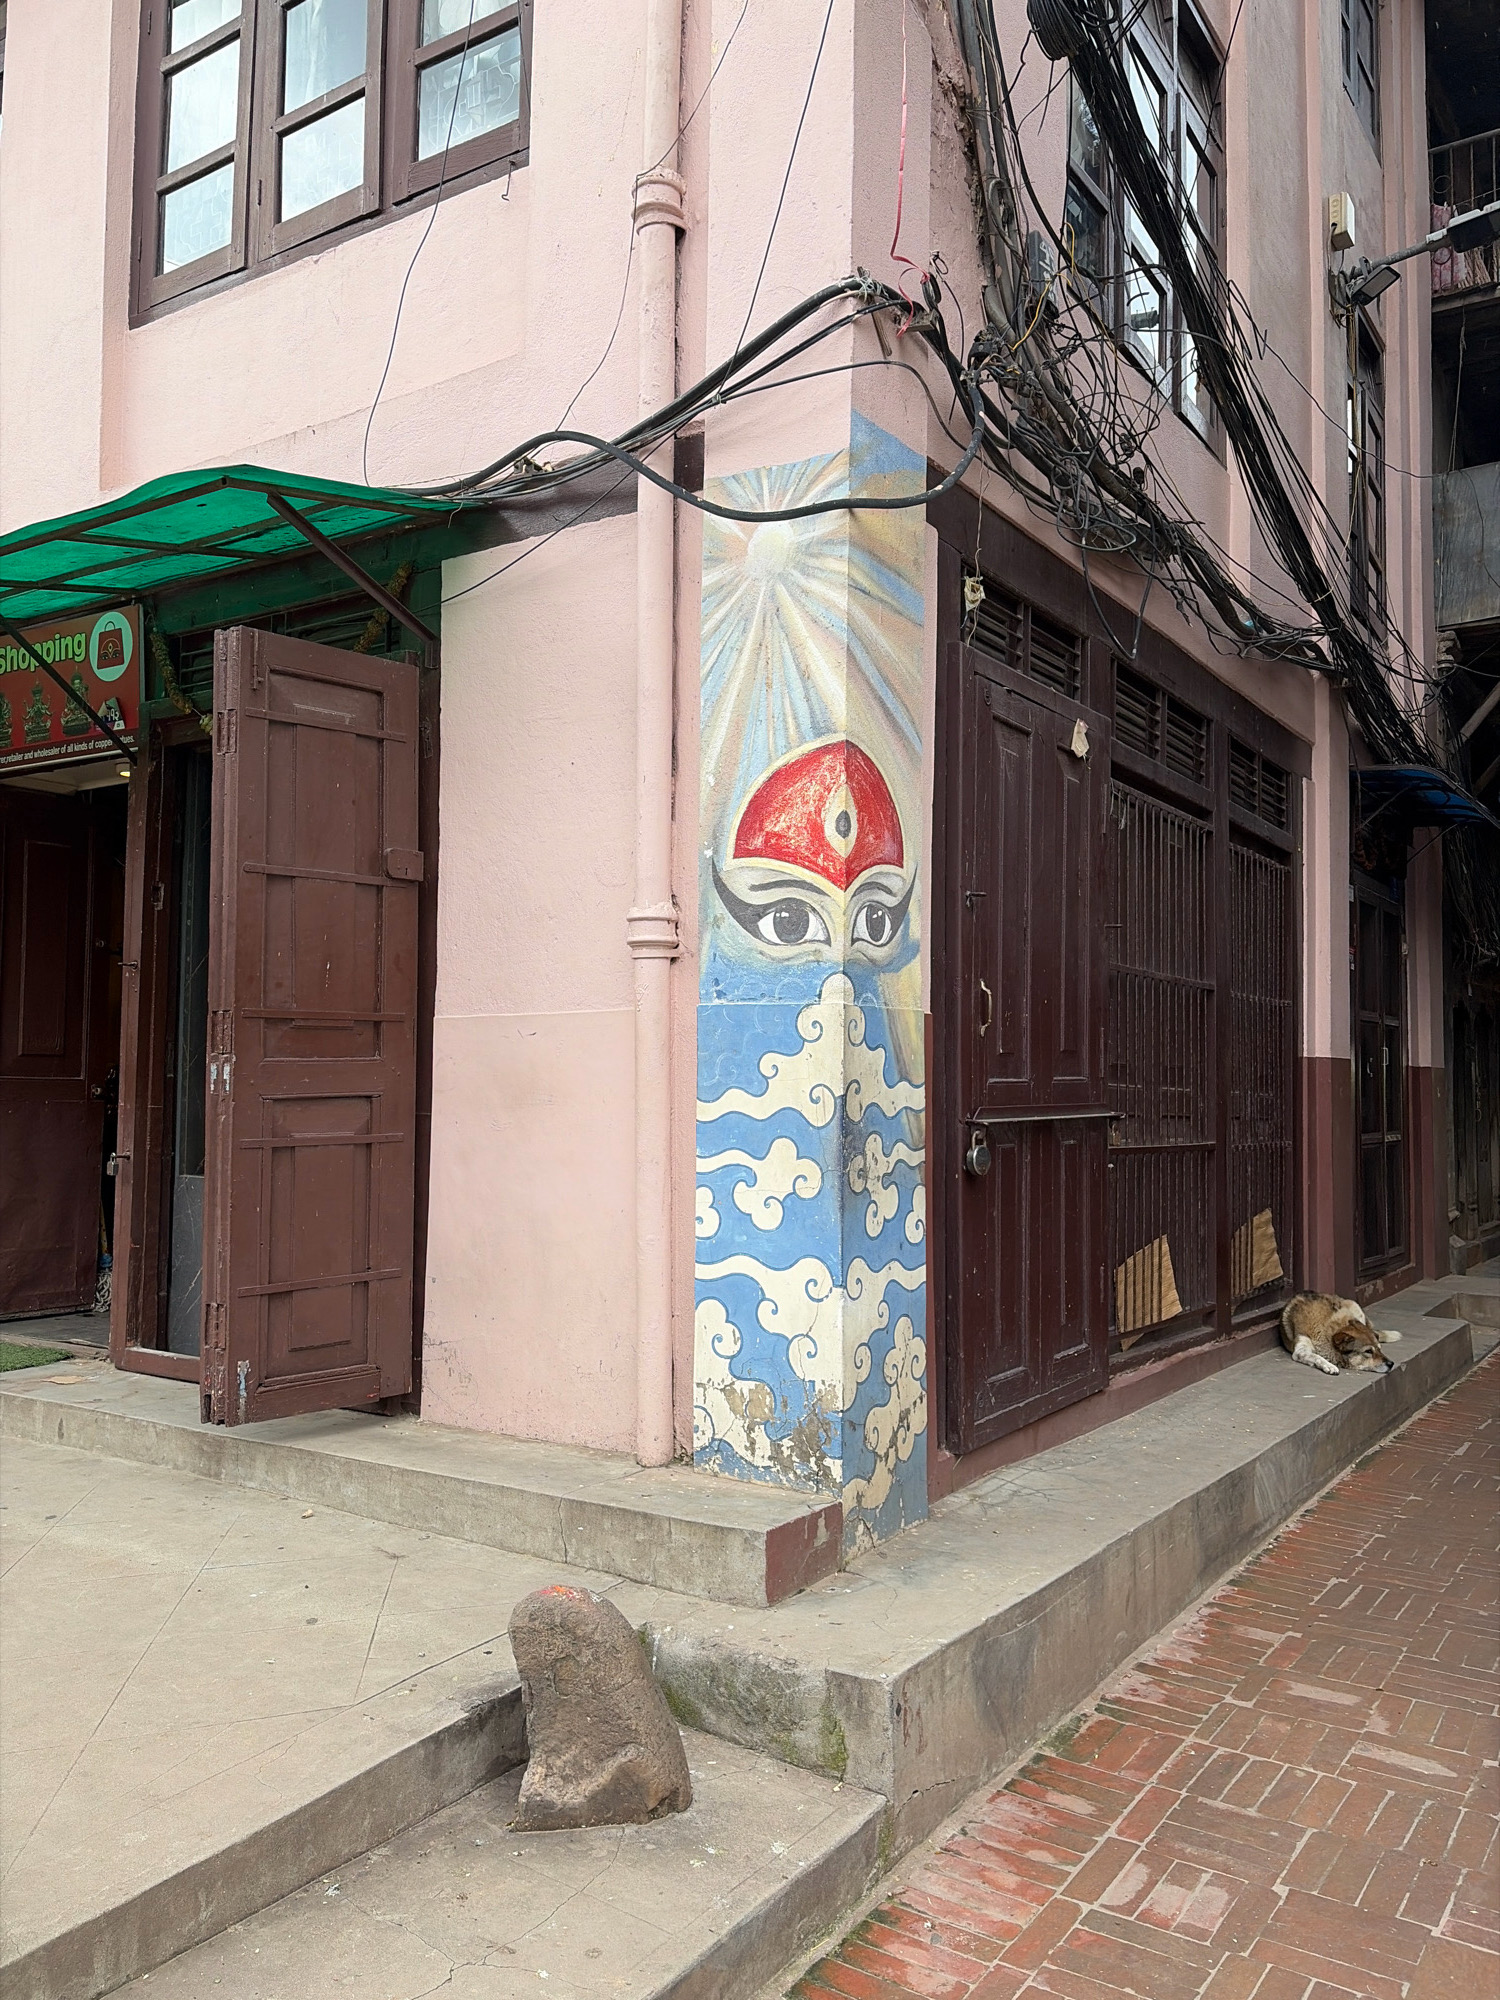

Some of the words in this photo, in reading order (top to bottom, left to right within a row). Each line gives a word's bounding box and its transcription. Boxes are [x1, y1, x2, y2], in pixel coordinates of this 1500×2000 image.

[24, 750, 33, 760] and
[34, 746, 60, 758] wholesaler
[60, 744, 66, 754] of
[74, 741, 88, 751] kinds
[88, 740, 94, 750] of
